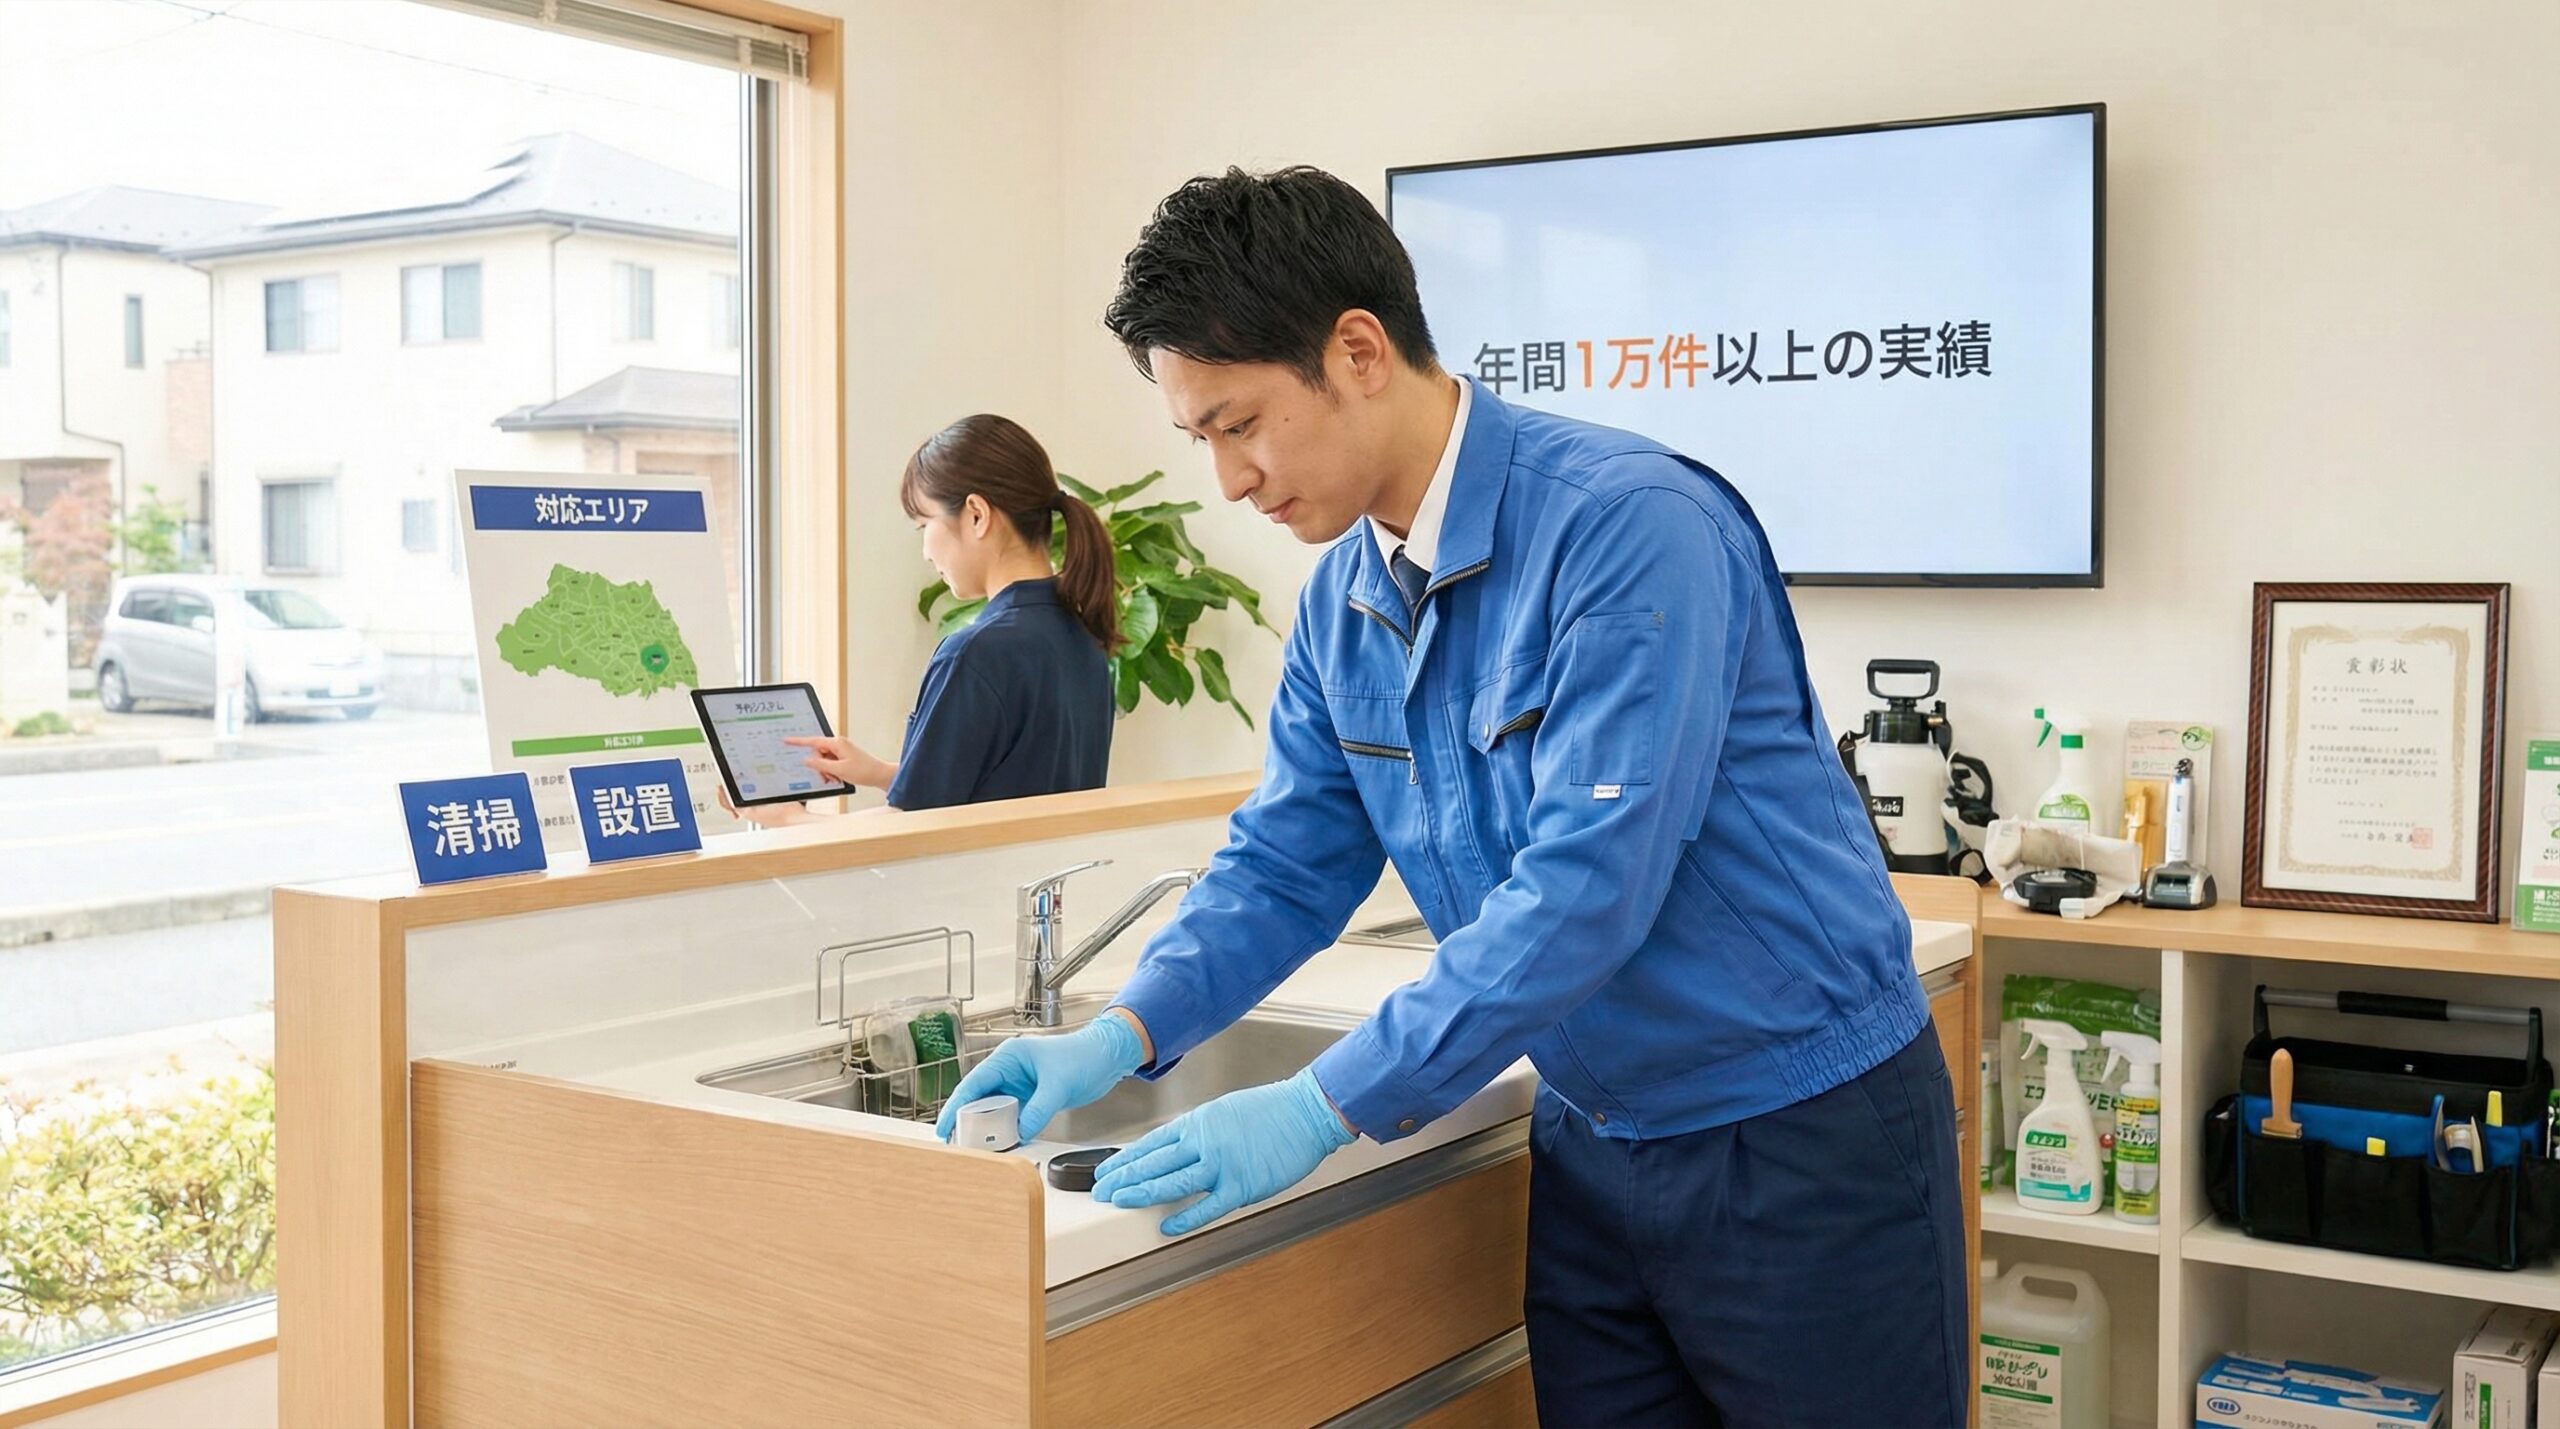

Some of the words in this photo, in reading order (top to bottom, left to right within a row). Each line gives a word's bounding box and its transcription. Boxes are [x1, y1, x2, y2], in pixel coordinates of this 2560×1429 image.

[1474, 320, 1991, 394] 年間1万件以上の実績
[535, 493, 649, 525] 対応エリア
[426, 798, 522, 858] 清掃
[593, 783, 681, 838] 設置
